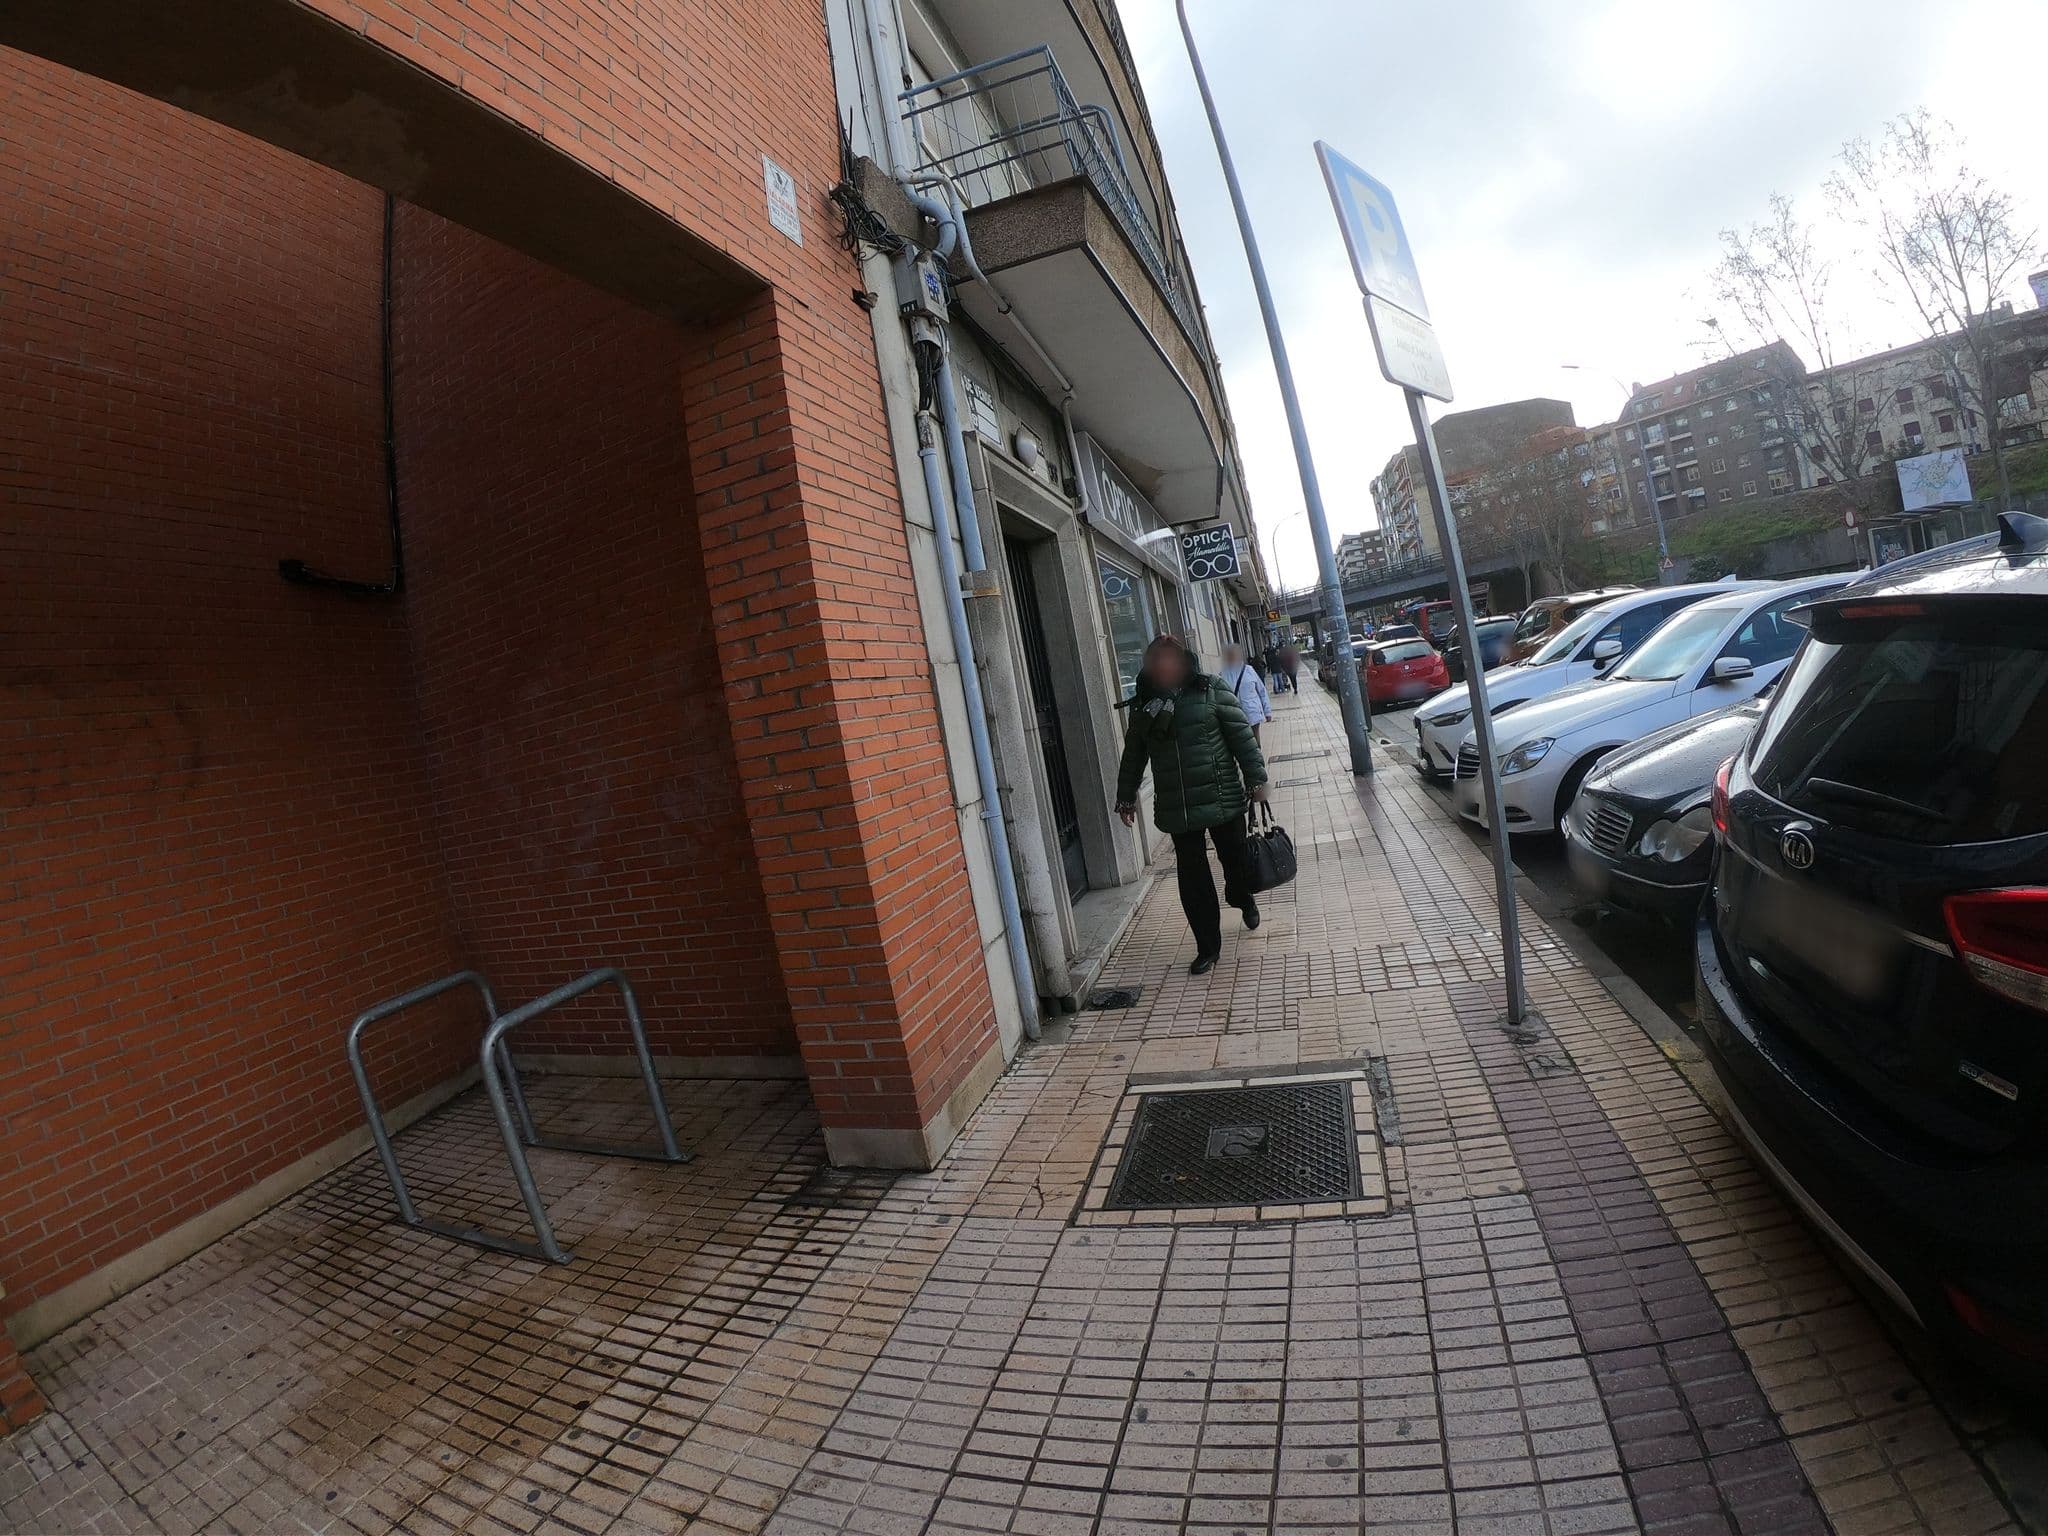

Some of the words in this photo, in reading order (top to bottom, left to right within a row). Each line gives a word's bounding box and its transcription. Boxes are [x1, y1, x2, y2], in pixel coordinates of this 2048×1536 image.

[1345, 171, 1399, 282] P
[1182, 529, 1231, 549] ÓPTICA
[1783, 836, 1807, 865] KIA
